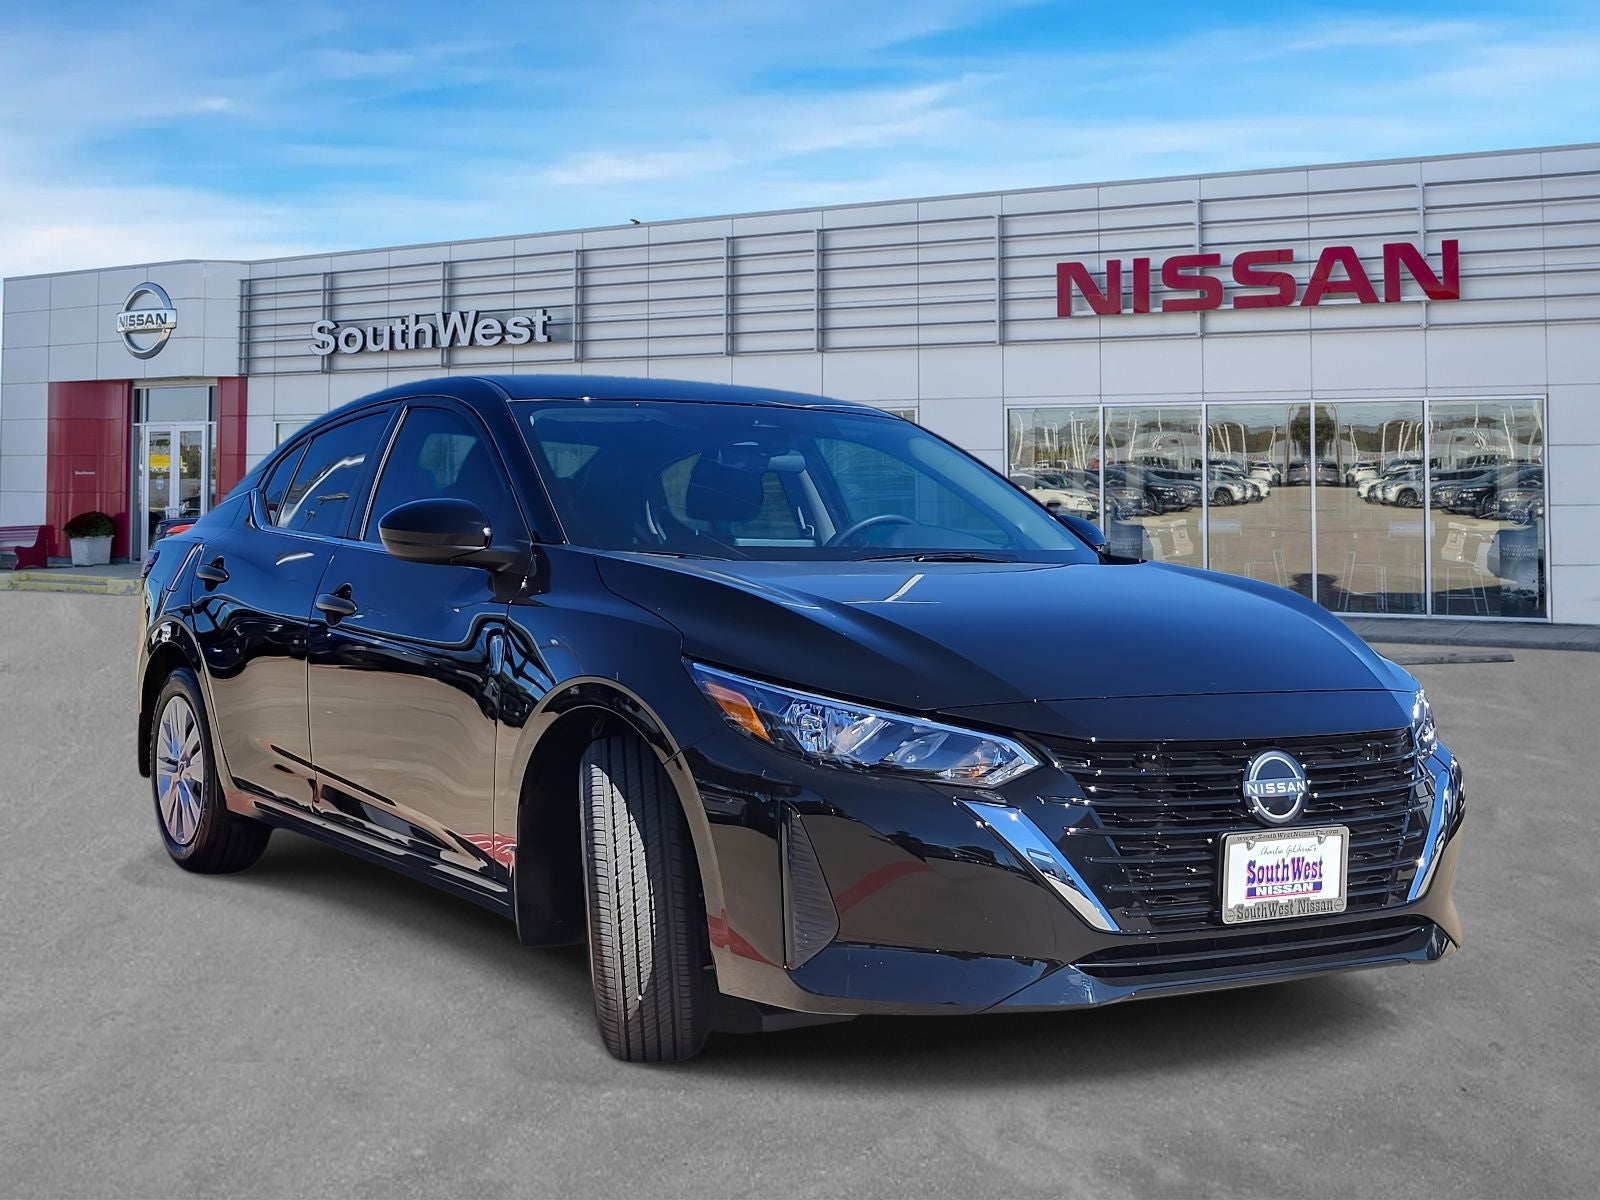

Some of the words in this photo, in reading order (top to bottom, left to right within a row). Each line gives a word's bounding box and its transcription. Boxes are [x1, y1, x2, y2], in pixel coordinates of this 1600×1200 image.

[1057, 239, 1460, 318] NISSAN
[119, 312, 167, 328] NISSAN
[308, 308, 551, 356] SouthWest
[1246, 780, 1306, 795] NISSAN
[1246, 855, 1323, 886] SouthWest
[1255, 882, 1314, 896] NISSAN
[1236, 901, 1294, 920] SouthWest
[1298, 899, 1334, 914] Nissan
